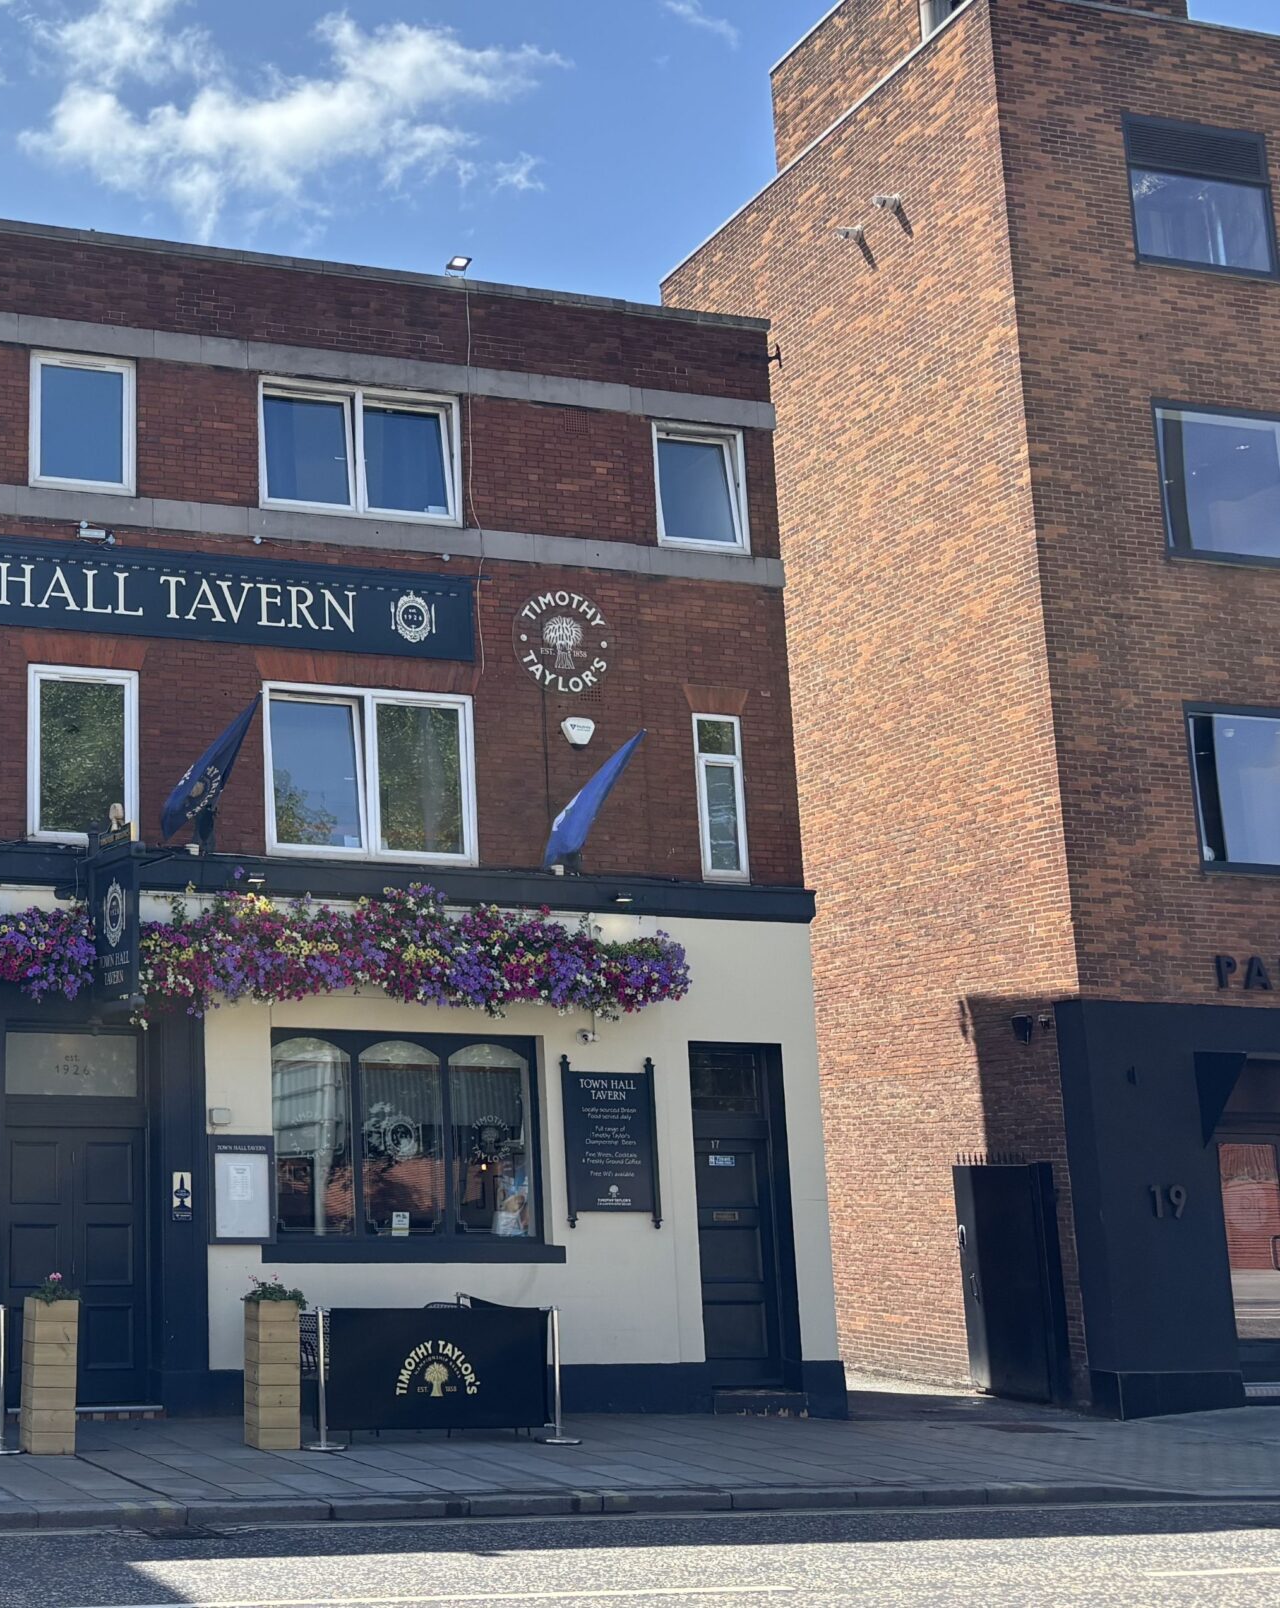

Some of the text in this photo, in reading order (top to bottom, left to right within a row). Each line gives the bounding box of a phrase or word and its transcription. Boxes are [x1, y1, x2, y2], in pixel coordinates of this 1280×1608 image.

[159, 574, 357, 633] TAVERN
[521, 590, 606, 628] TIMOTHY
[540, 647, 556, 656] EST.
[521, 650, 608, 692] TAYLOR'S
[115, 950, 130, 966] HALL
[104, 970, 123, 985] TAVERN
[1216, 954, 1280, 990] PA
[64, 1053, 80, 1062] est.
[55, 1064, 90, 1075] 1926
[579, 1079, 637, 1090] TOWN HALL
[590, 1090, 626, 1100] TAVERN
[472, 1115, 509, 1131] TIMOTHY
[711, 1140, 720, 1149] 17
[1149, 1184, 1187, 1219] 19
[395, 1340, 432, 1396] TIMOTHY
